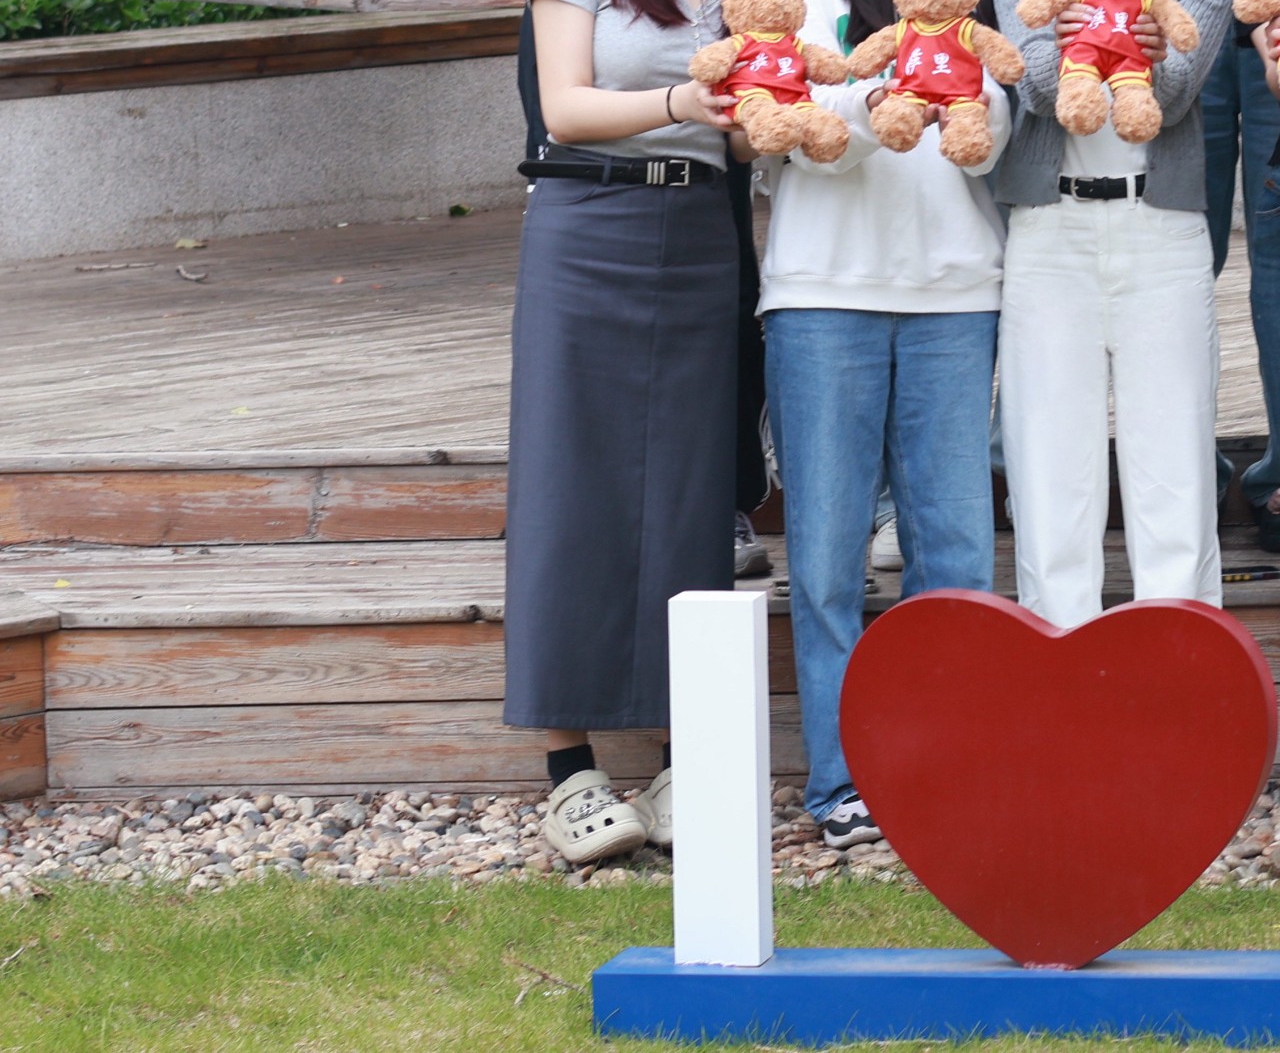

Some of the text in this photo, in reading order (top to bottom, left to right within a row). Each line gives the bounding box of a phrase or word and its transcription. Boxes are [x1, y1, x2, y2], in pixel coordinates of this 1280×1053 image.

[749, 51, 797, 77] 萨里
[904, 46, 952, 76] 萨里
[668, 590, 774, 968] I
